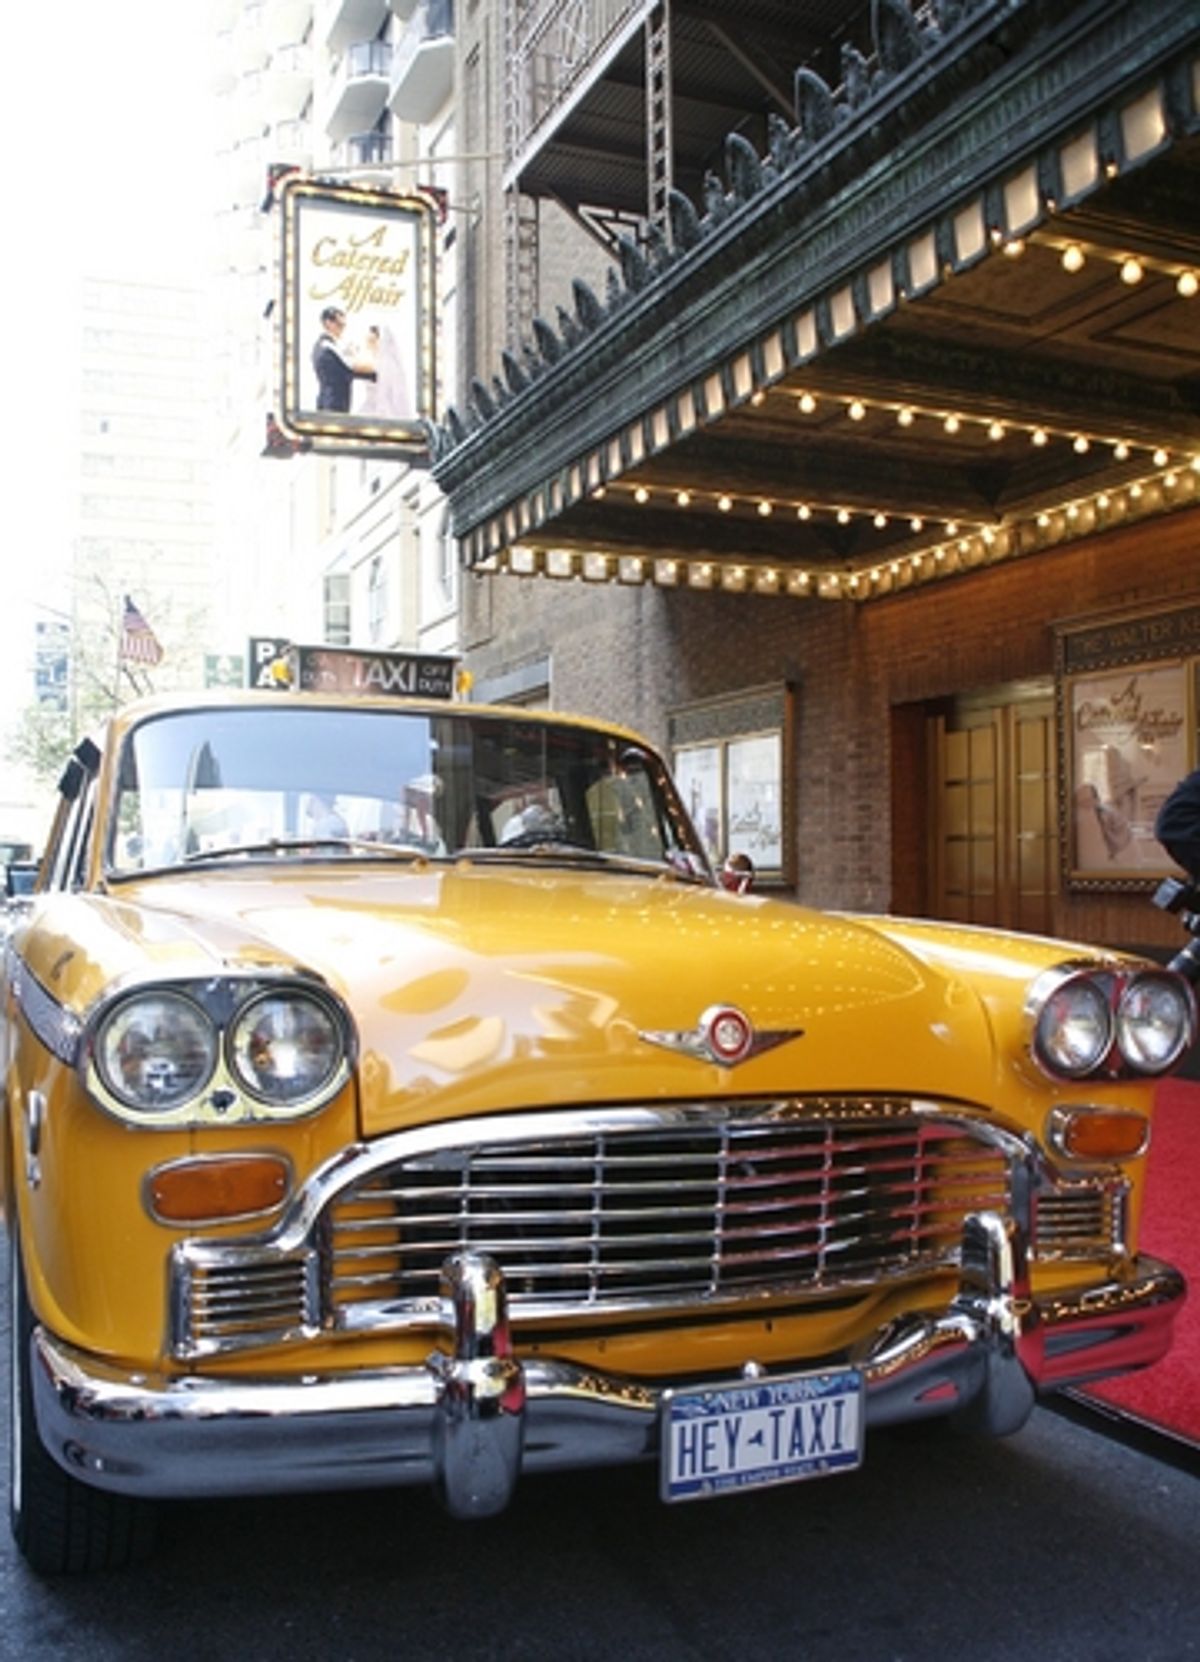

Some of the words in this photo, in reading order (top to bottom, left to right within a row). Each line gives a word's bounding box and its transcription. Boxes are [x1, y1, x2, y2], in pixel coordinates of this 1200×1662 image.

[350, 225, 387, 247] A
[312, 237, 409, 275] Catered
[309, 275, 405, 313] Affair
[346, 657, 418, 693] TAXI
[678, 1415, 742, 1477] HEY
[768, 1400, 846, 1461] TAXI
